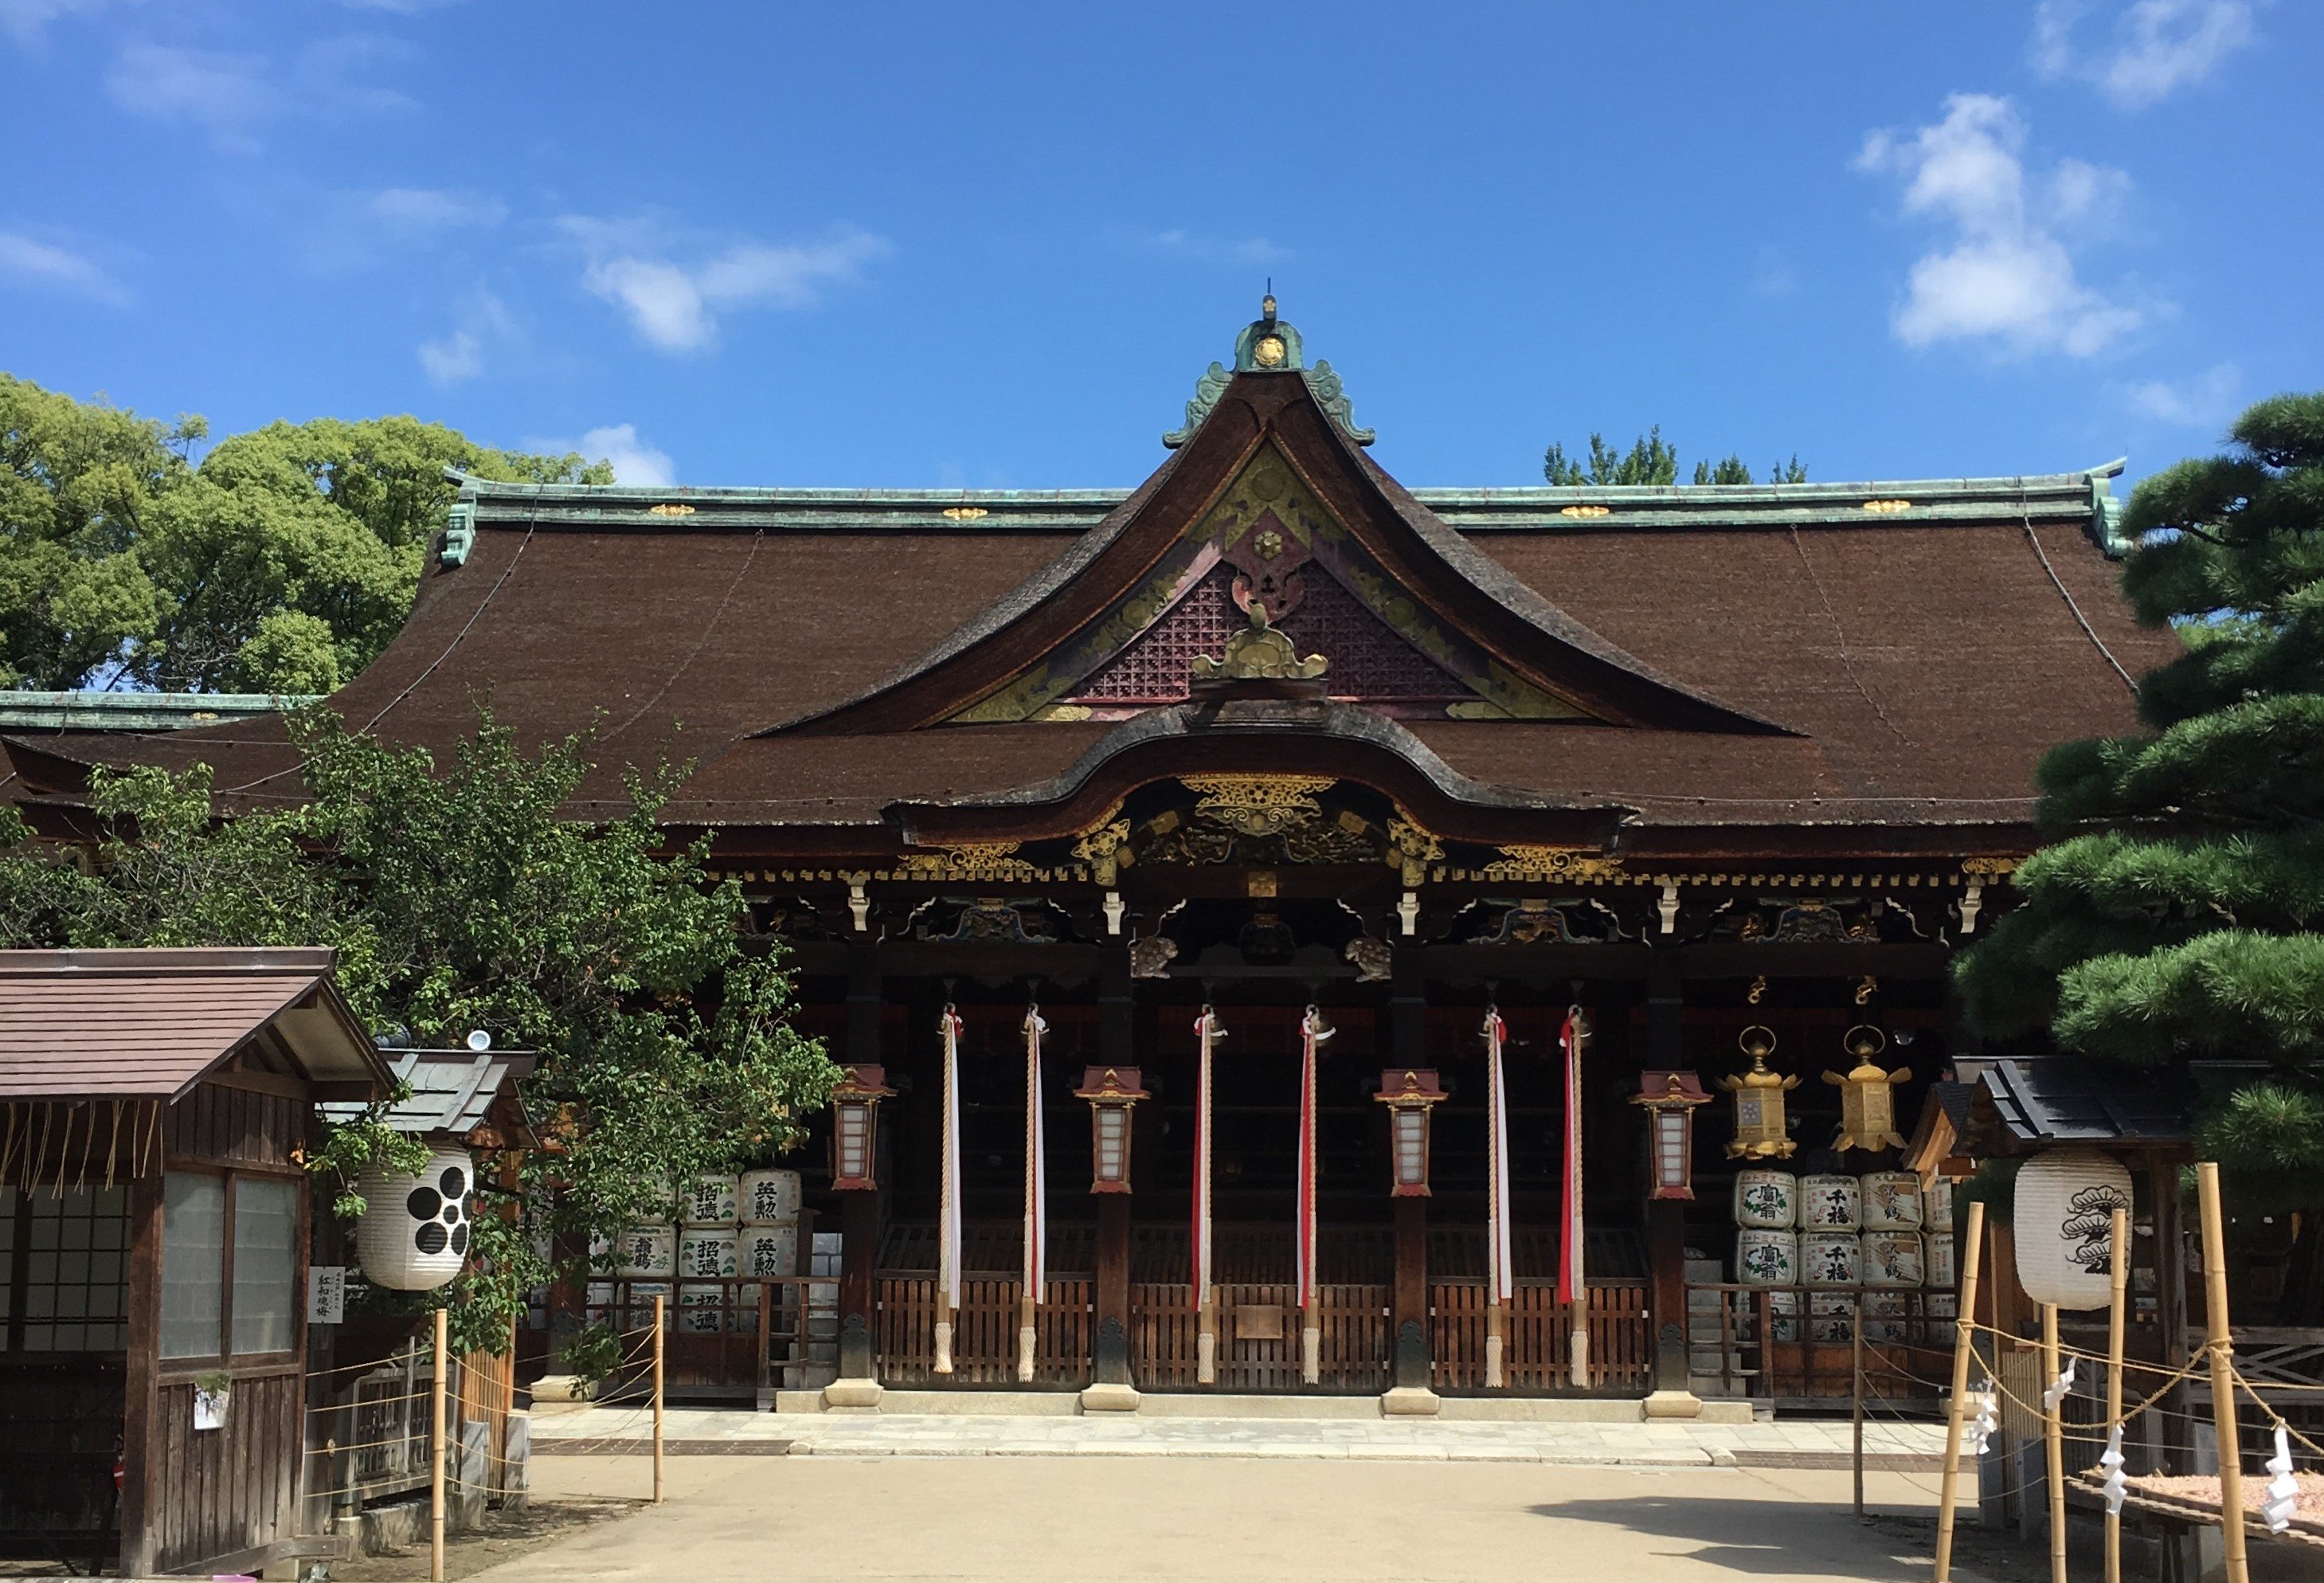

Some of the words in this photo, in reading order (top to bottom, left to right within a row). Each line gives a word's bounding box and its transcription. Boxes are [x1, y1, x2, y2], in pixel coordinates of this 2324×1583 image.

[754, 1181, 777, 1220] 英勲
[1826, 1189, 1849, 1224] 千福
[753, 1237, 777, 1275] 英勲
[1825, 1245, 1848, 1281] 千福
